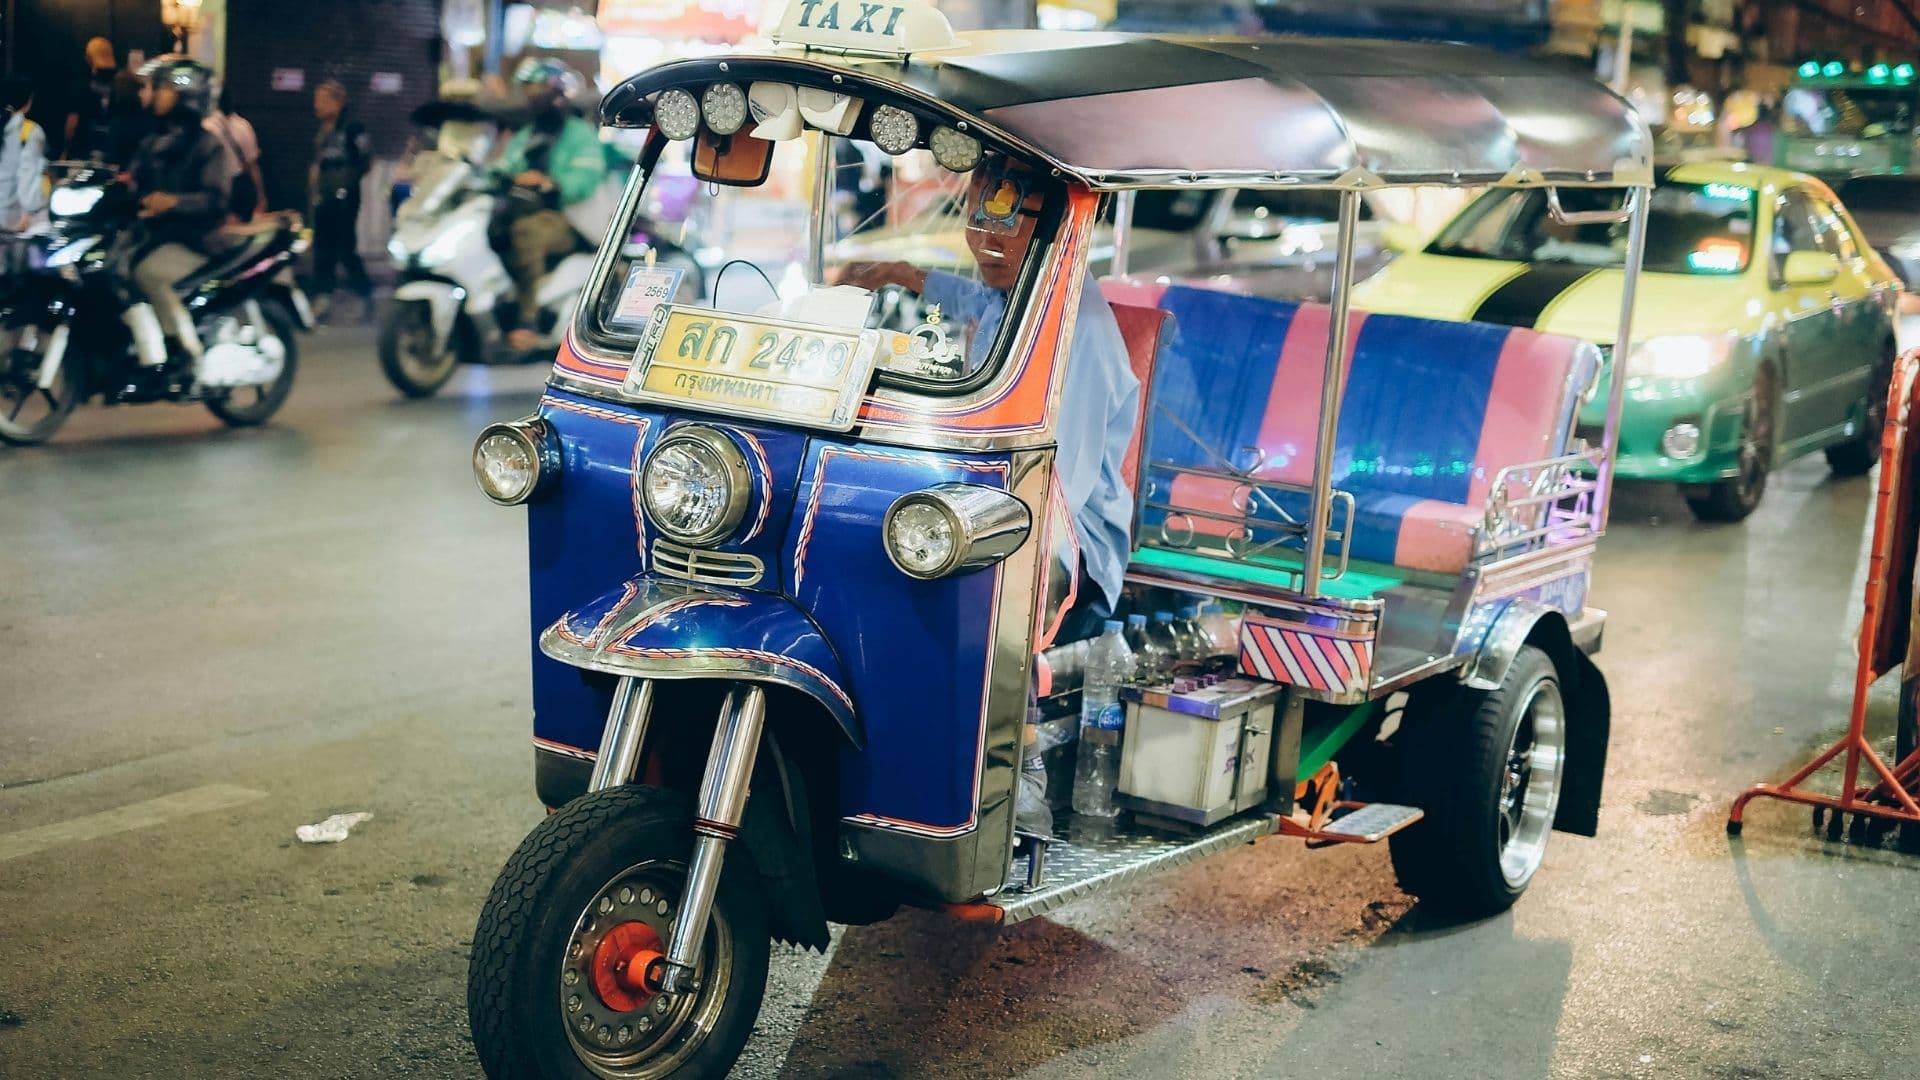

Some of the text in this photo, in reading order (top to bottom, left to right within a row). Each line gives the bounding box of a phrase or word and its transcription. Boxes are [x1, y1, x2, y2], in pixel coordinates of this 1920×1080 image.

[798, 0, 905, 36] TAXI
[644, 286, 669, 298] 2569
[677, 320, 738, 364] สก
